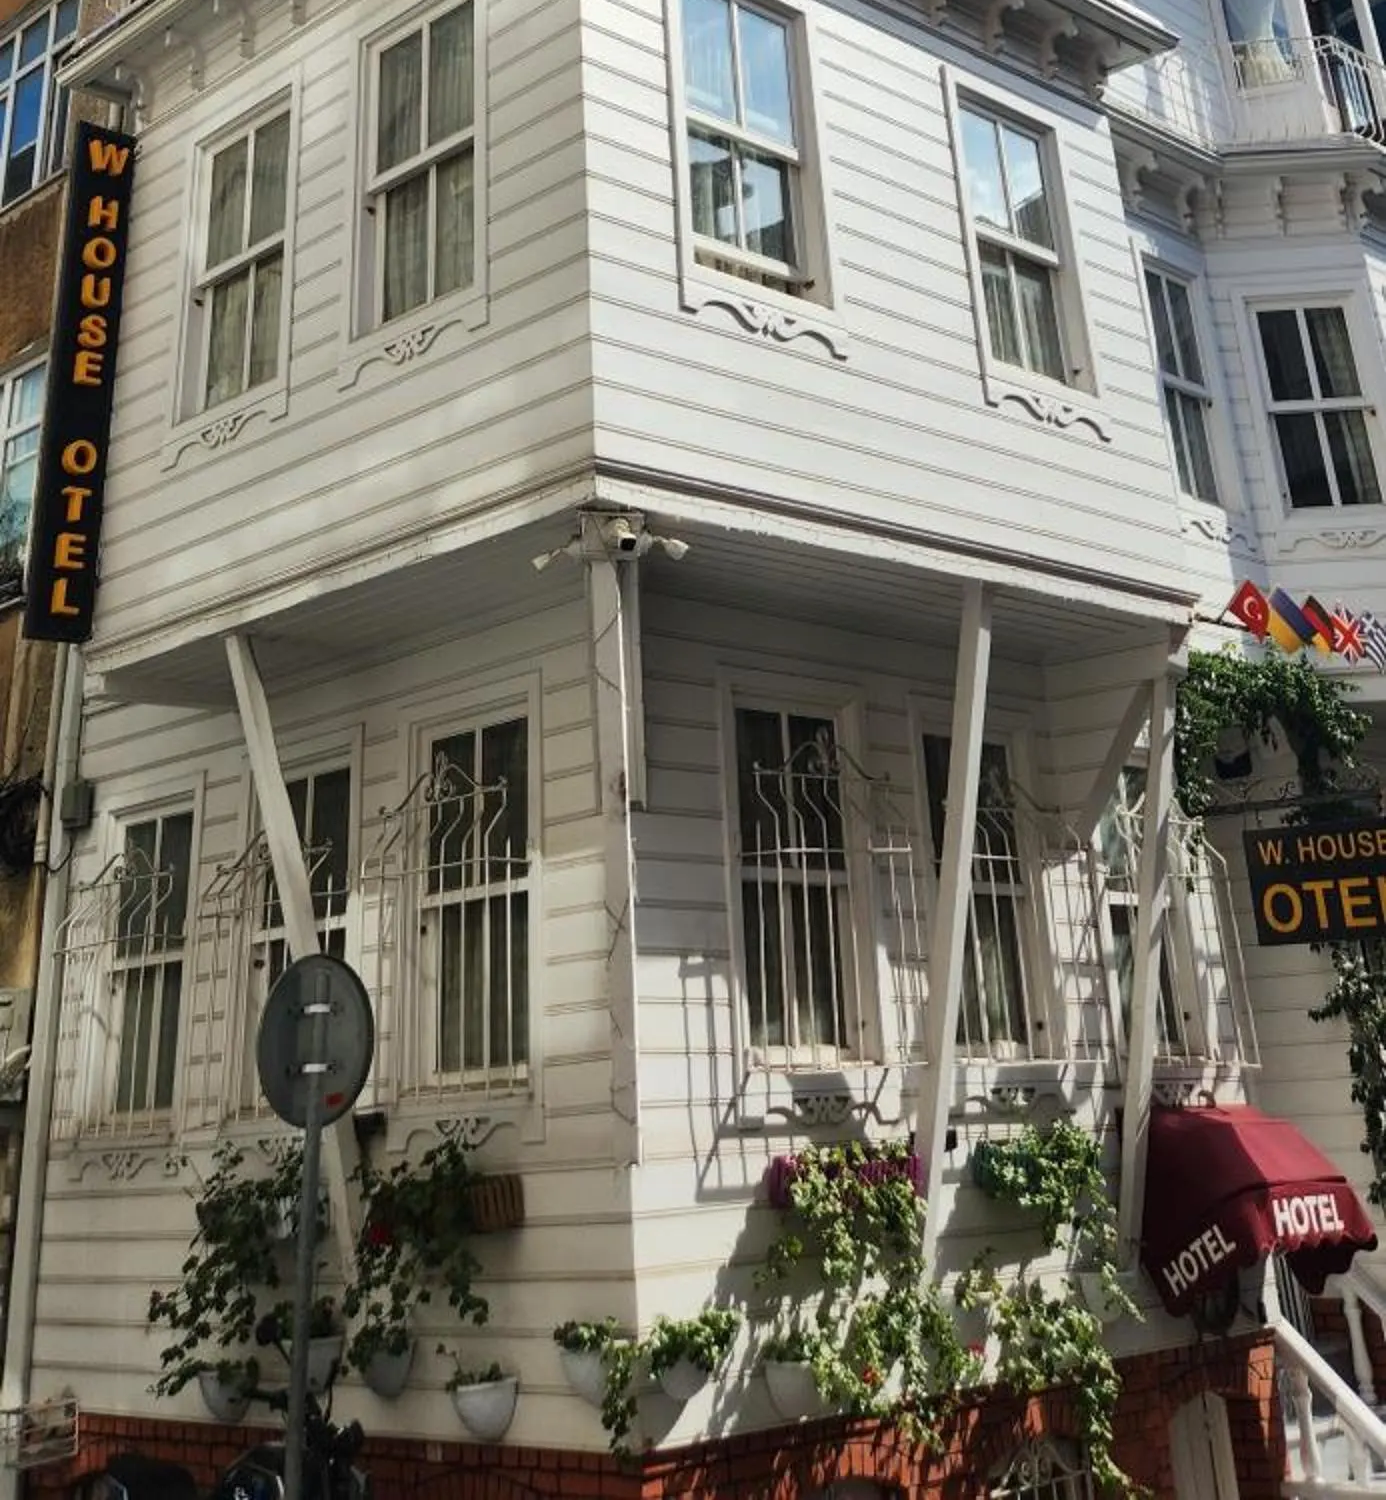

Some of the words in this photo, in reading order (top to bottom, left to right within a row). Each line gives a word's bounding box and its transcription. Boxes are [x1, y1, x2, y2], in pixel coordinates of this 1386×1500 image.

[89, 138, 129, 177] W
[73, 195, 117, 386] HOUSE
[51, 438, 97, 617] OTEL
[1257, 838, 1290, 866] W.
[1272, 1194, 1345, 1237] HOTEL
[1162, 1224, 1237, 1297] HOTEL
